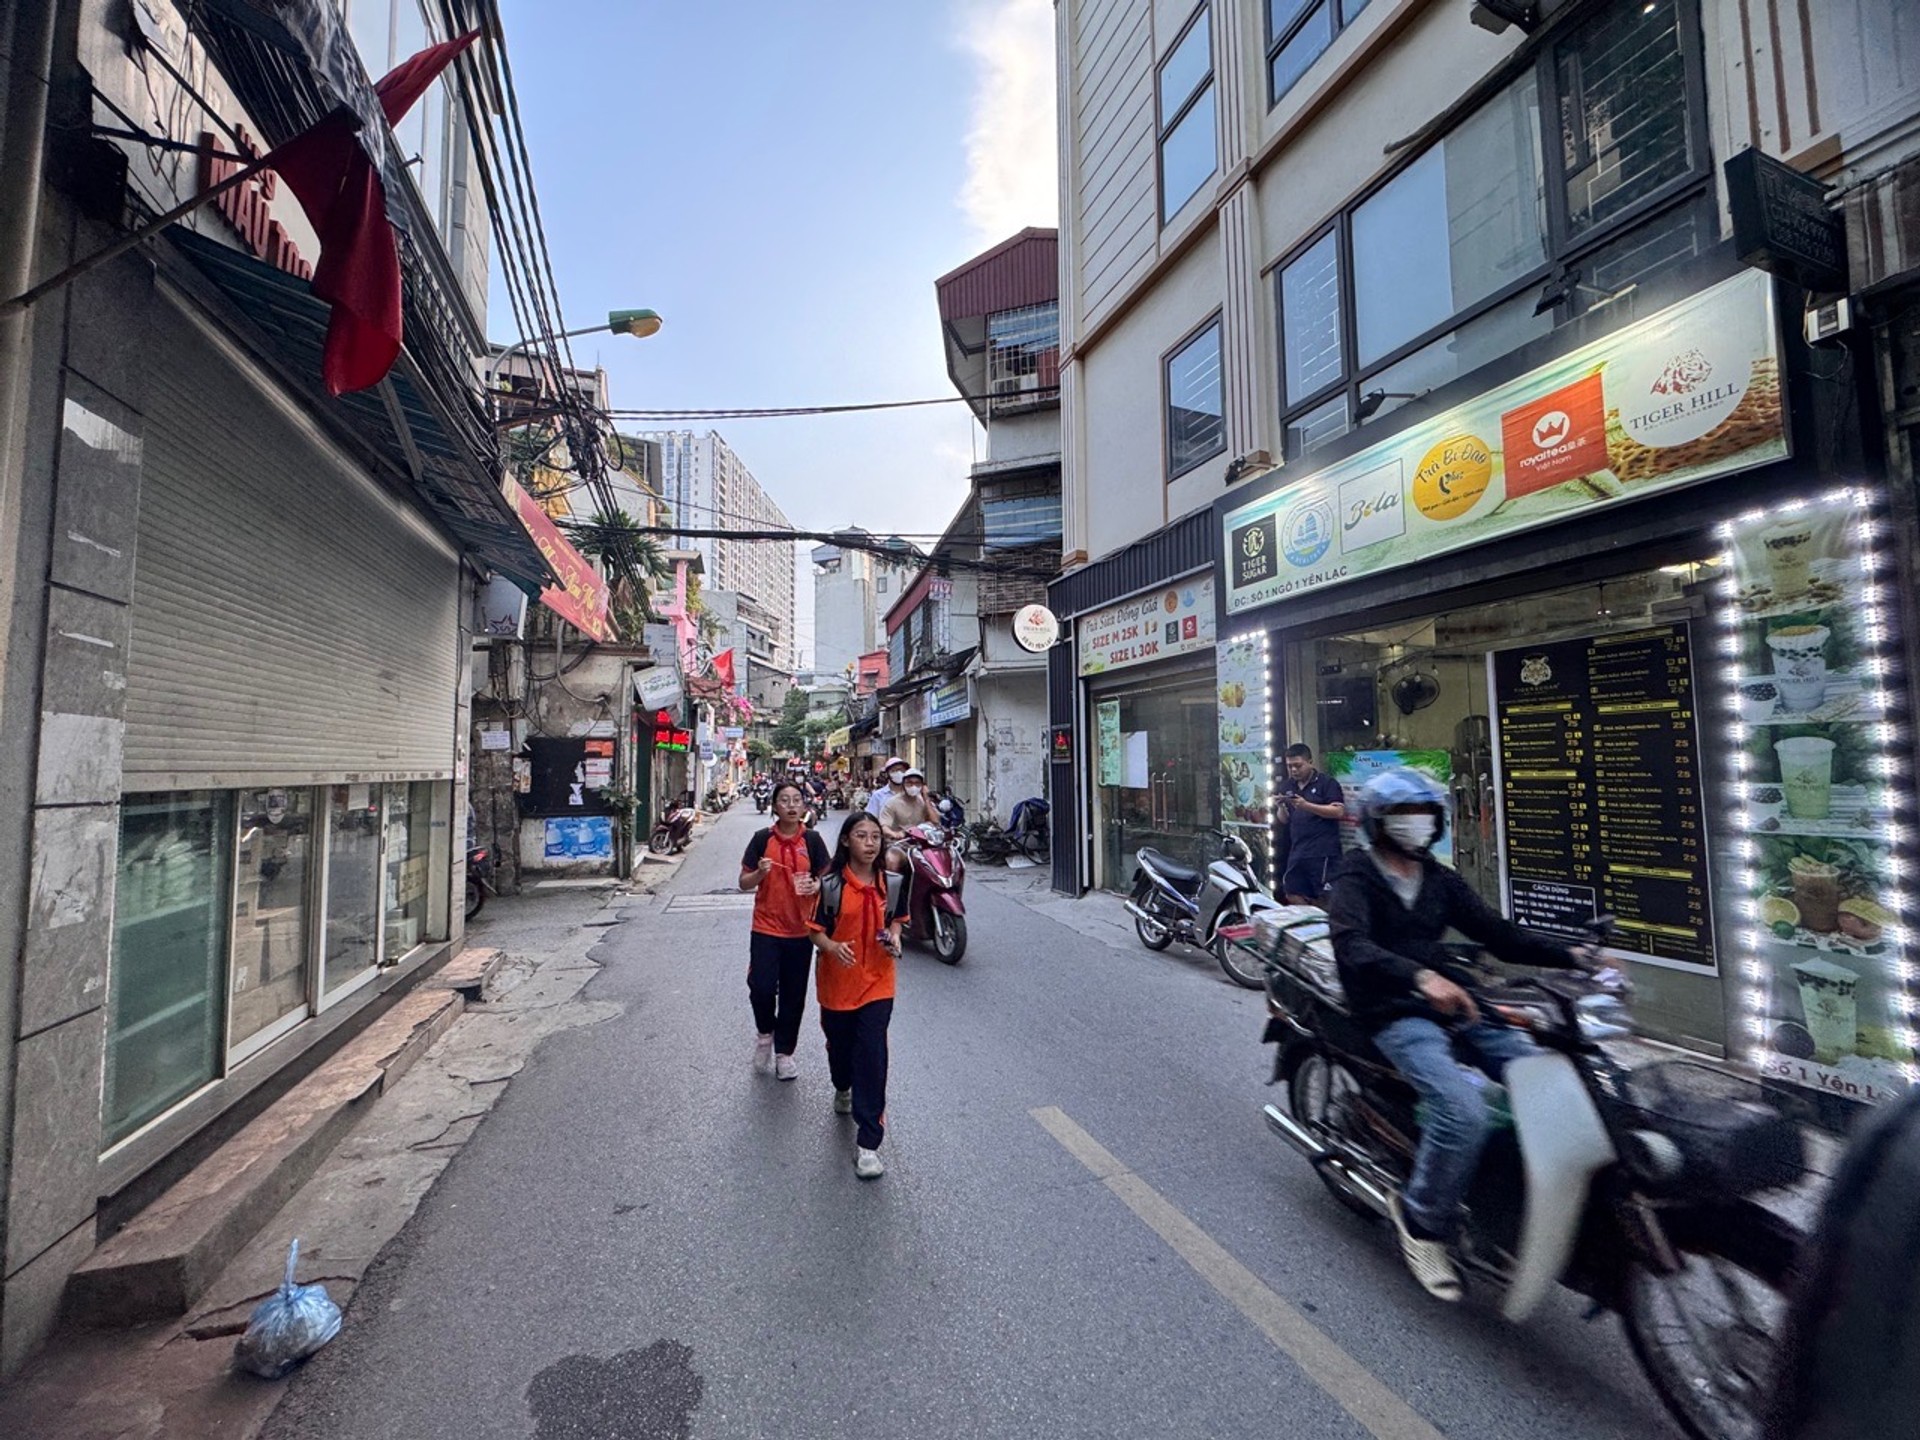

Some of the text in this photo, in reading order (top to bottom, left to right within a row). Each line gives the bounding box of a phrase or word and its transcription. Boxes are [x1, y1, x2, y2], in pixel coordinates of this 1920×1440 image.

[1629, 402, 1684, 429] TIGER
[1691, 382, 1740, 408] HILL
[1552, 455, 1572, 466] Nam
[1242, 555, 1267, 571] TIGER
[1242, 566, 1267, 581] SUGAR
[1265, 588, 1270, 599] 1
[1295, 581, 1300, 590] 1
[1302, 573, 1323, 586] YÊN
[1326, 566, 1347, 581] LẠC
[1092, 625, 1139, 649] SIZE M 25K
[1110, 641, 1159, 664] SIZE L 30K
[1680, 805, 1695, 814] 25
[1680, 820, 1695, 829] 25
[1681, 837, 1696, 846] 25
[1682, 853, 1697, 862] 25
[1798, 1066, 1807, 1080] 1
[1817, 1071, 1858, 1094] Yên
